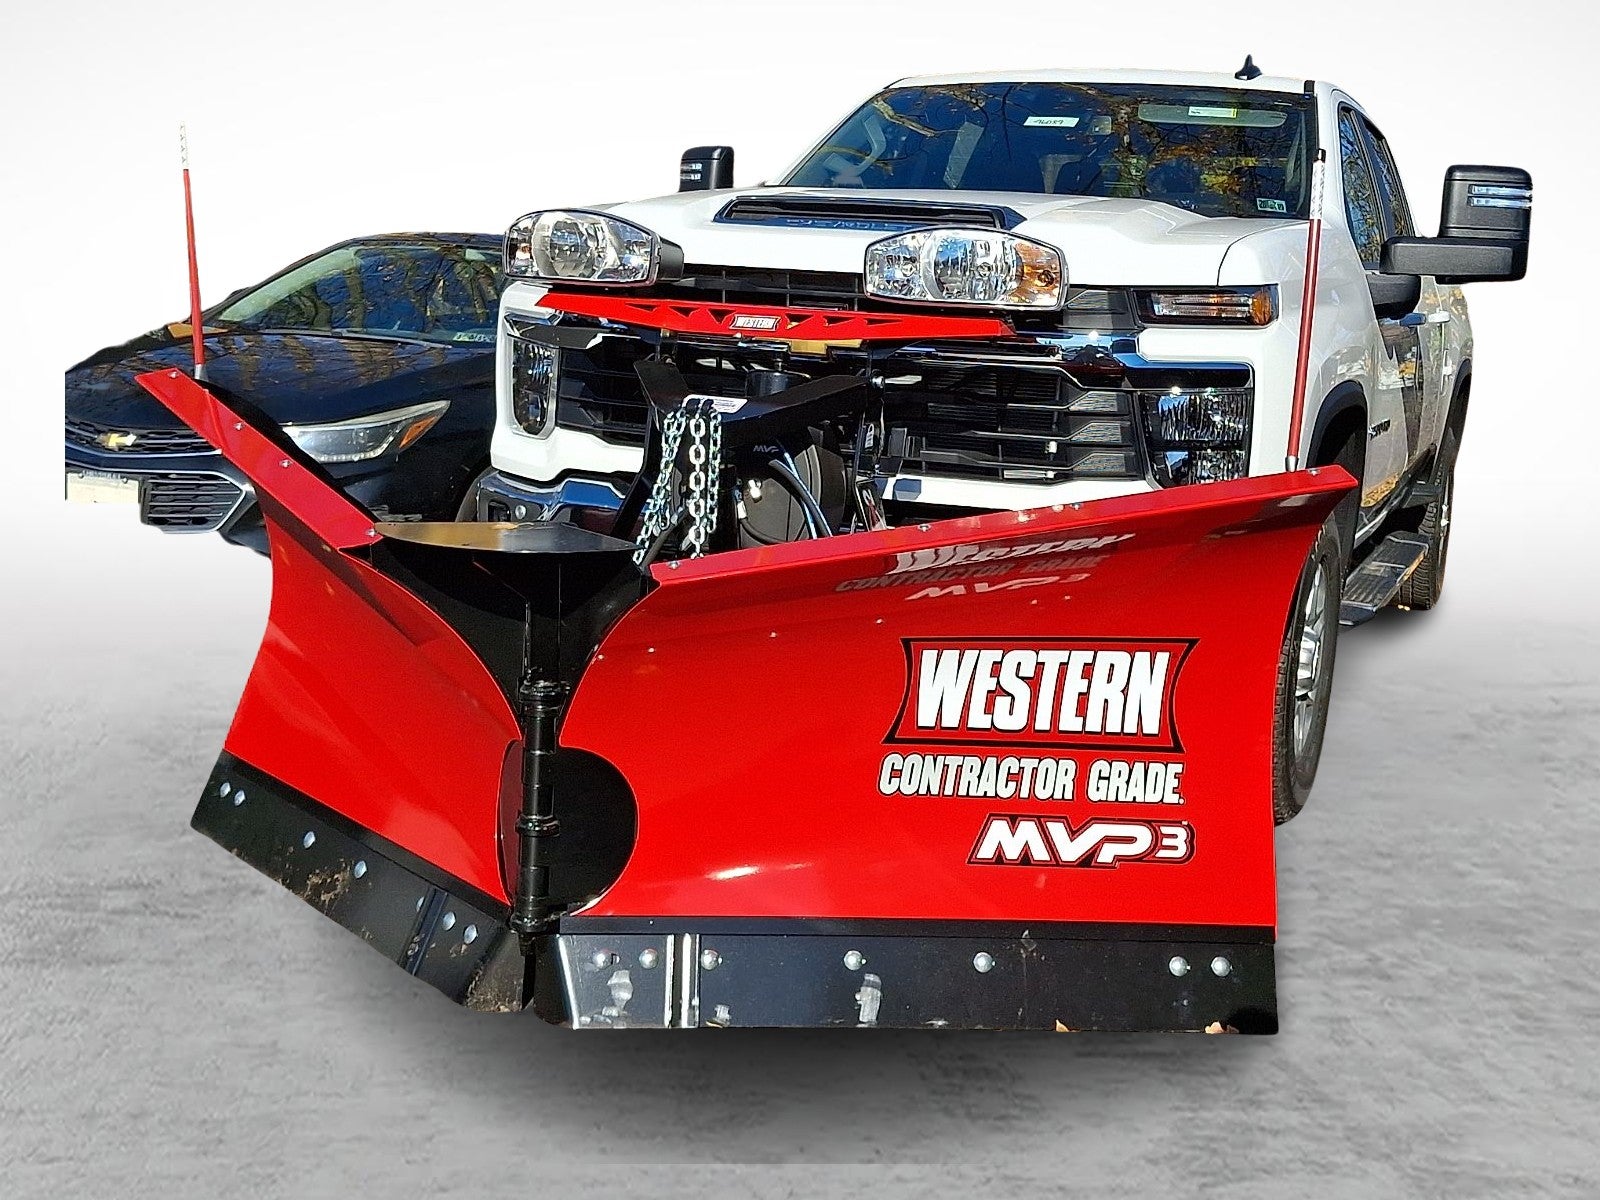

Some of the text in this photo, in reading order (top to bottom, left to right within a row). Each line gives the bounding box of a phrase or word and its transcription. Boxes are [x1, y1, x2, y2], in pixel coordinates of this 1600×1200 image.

[917, 649, 1171, 735] WESTERN
[879, 753, 1077, 801] CONTRACTOR
[974, 817, 1191, 864] MVP3
